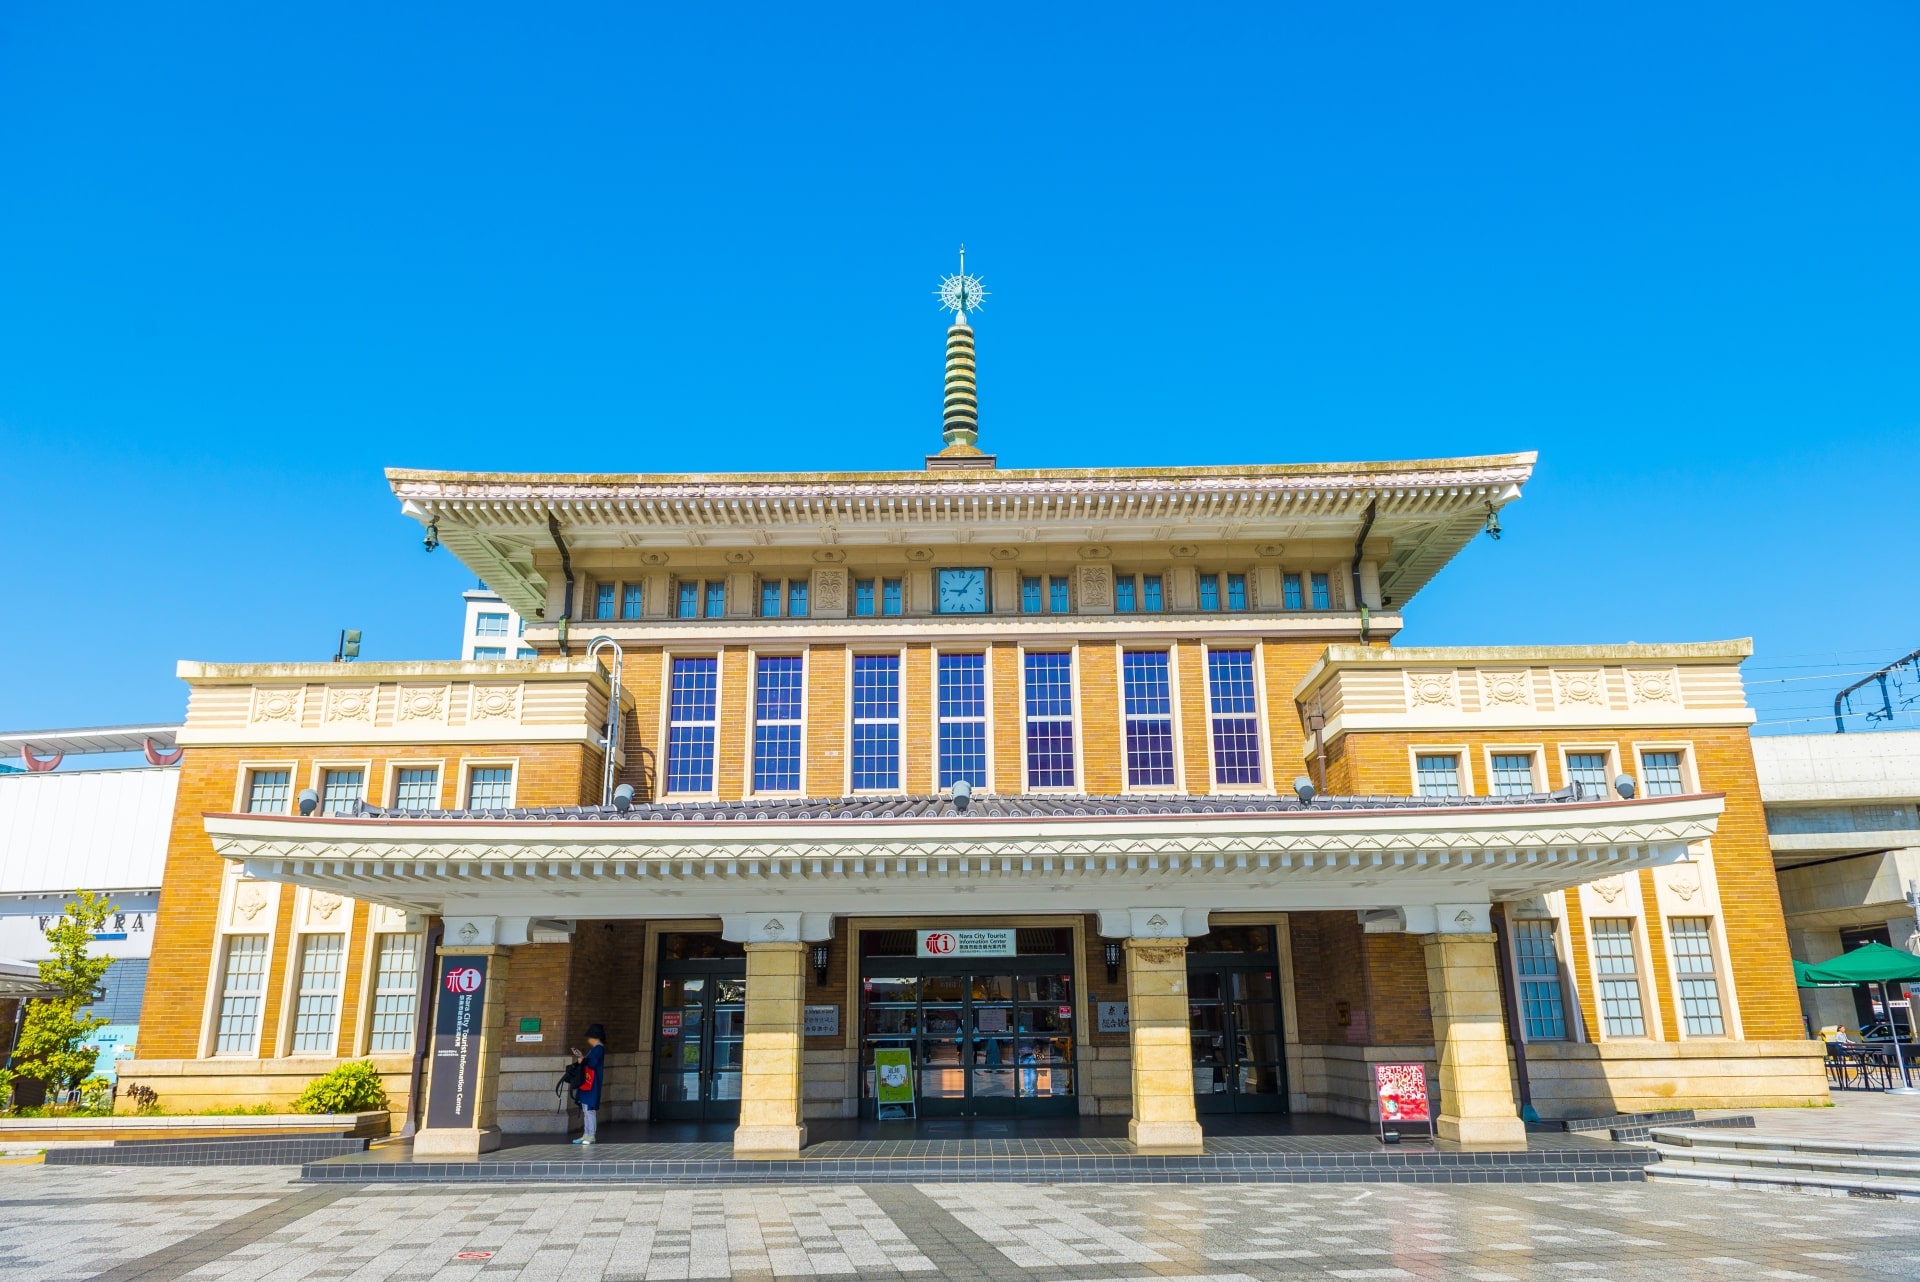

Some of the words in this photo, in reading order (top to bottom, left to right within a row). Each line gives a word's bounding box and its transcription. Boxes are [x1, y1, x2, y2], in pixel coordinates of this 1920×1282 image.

[941, 588, 946, 596] 9
[464, 994, 472, 1012] Nara
[462, 1013, 471, 1027] City
[460, 1028, 470, 1054] Tourist
[457, 1054, 467, 1092] Information
[455, 1093, 463, 1115] Center
